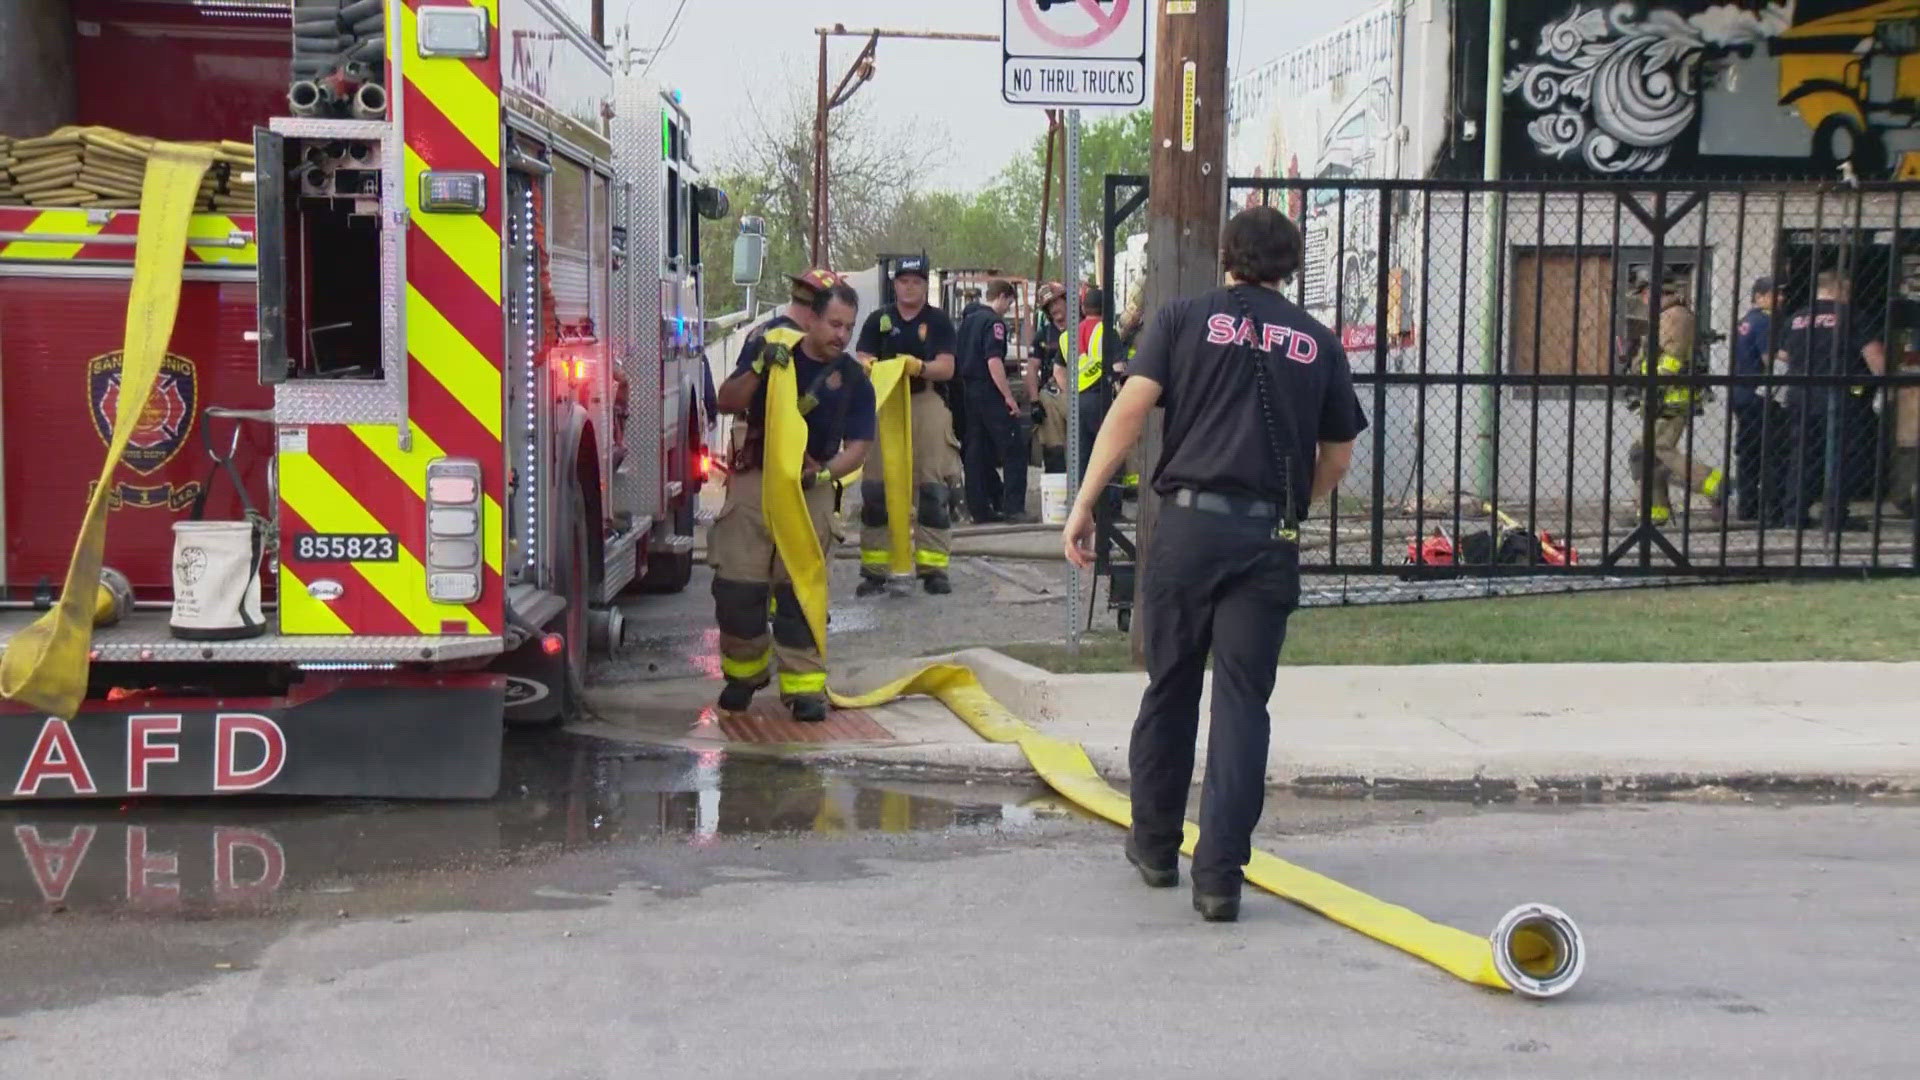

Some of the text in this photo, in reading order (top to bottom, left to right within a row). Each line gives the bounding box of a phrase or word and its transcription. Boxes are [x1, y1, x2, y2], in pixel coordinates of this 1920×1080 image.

[1014, 67, 1135, 94] NO THRU TRUCKS
[1207, 313, 1318, 364] SAFD
[299, 536, 394, 559] 855823
